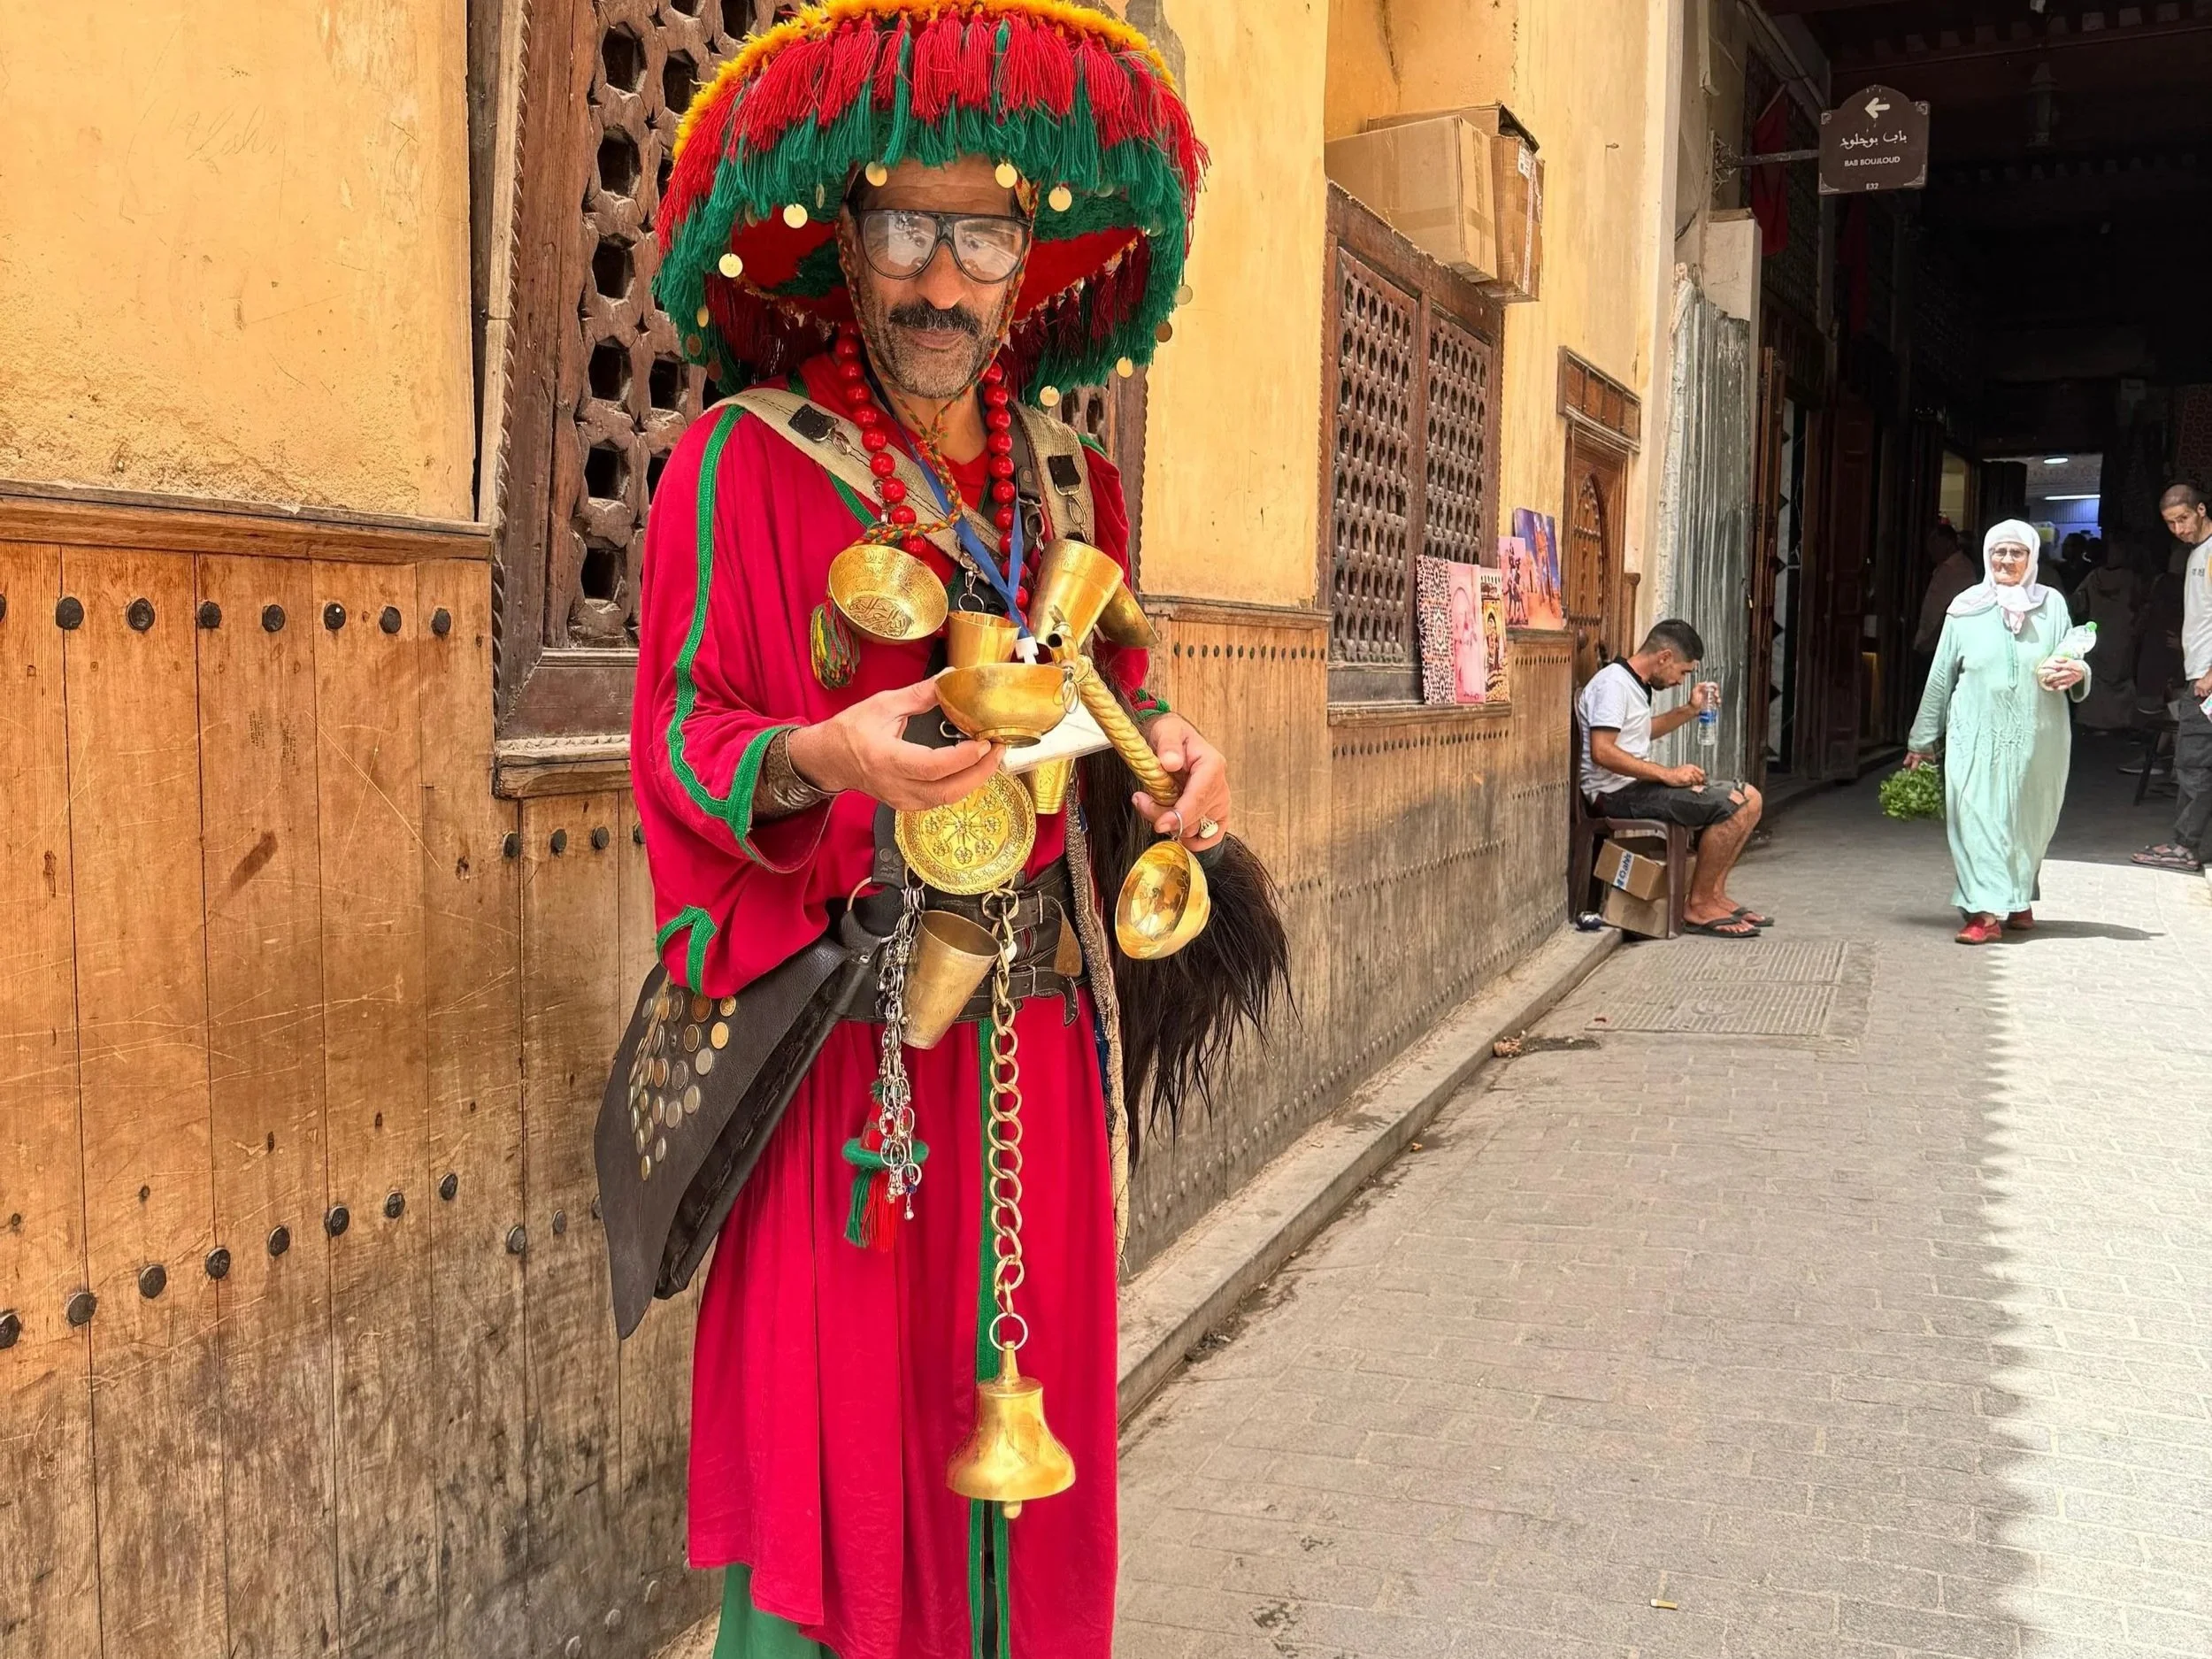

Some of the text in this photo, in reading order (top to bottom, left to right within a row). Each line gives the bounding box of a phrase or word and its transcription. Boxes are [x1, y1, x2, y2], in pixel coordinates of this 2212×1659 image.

[1839, 130, 1907, 150] باب بوجلود
[1860, 156, 1901, 166] BOUJLOUD
